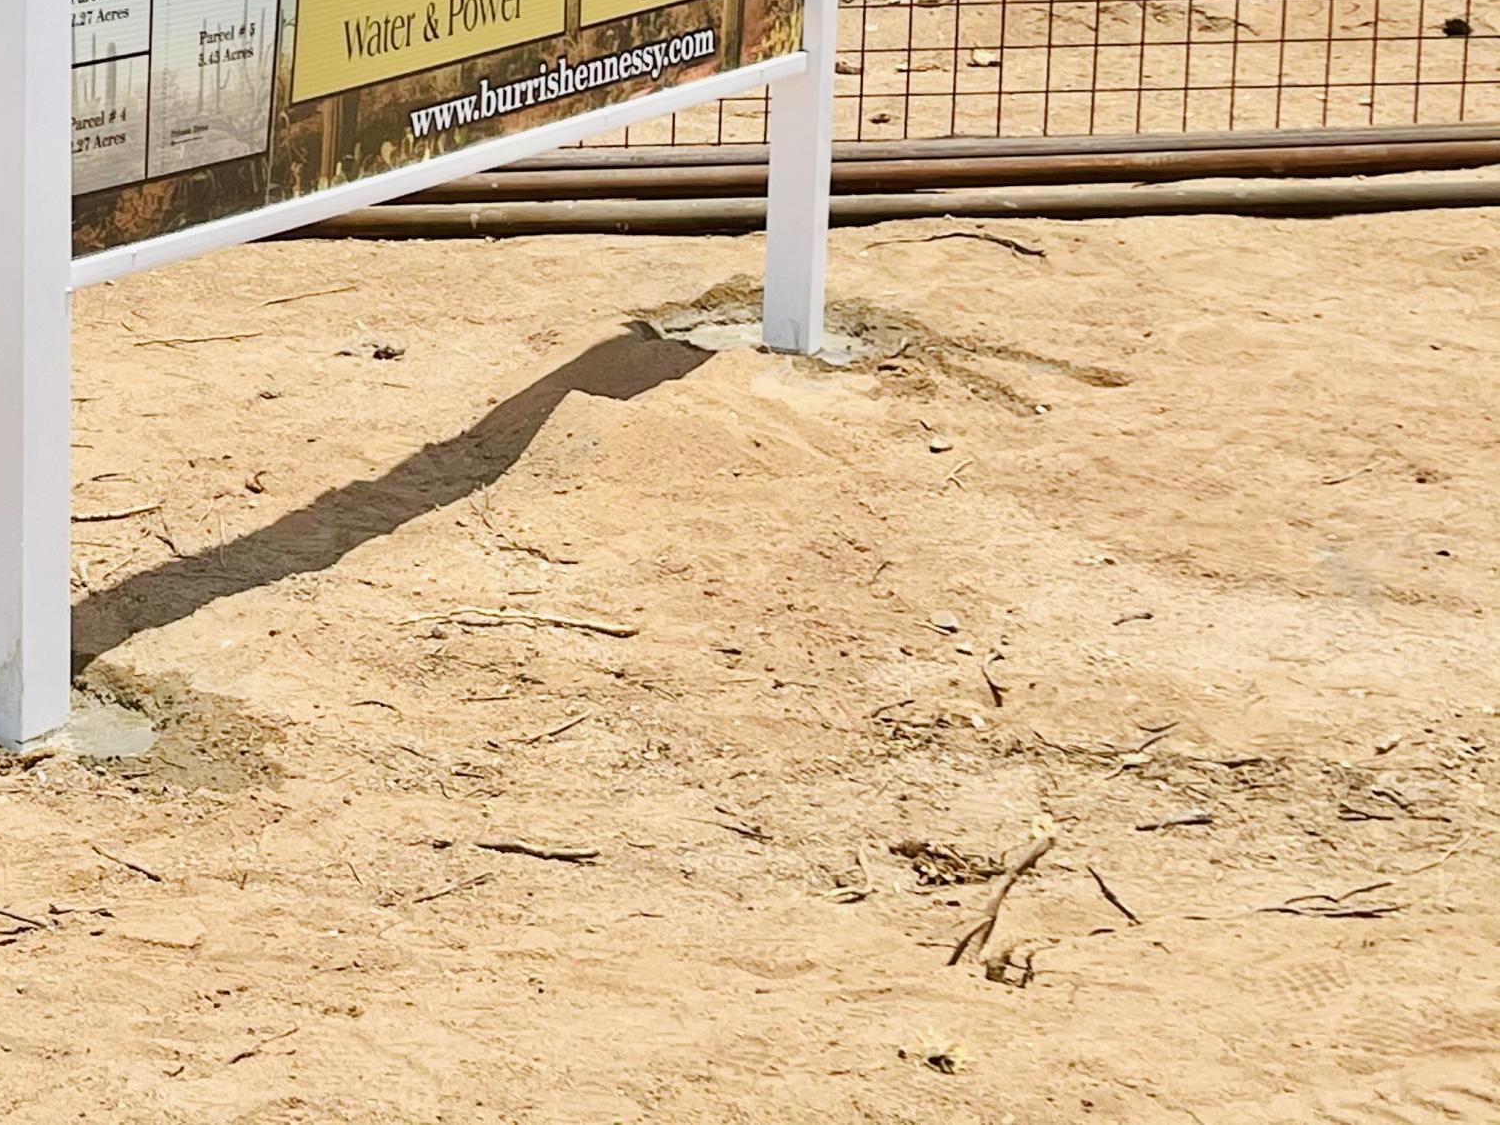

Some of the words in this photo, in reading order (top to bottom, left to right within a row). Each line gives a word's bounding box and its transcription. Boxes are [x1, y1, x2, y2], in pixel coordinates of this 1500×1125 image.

[95, 8, 129, 22] Acres
[199, 25, 235, 45] Parcel
[343, 10, 416, 64] Water
[422, 1, 440, 43] &
[222, 47, 254, 62] Acres
[409, 28, 715, 137] www.burrishennessy.com
[71, 137, 90, 154] .27
[93, 133, 126, 149] Acres
